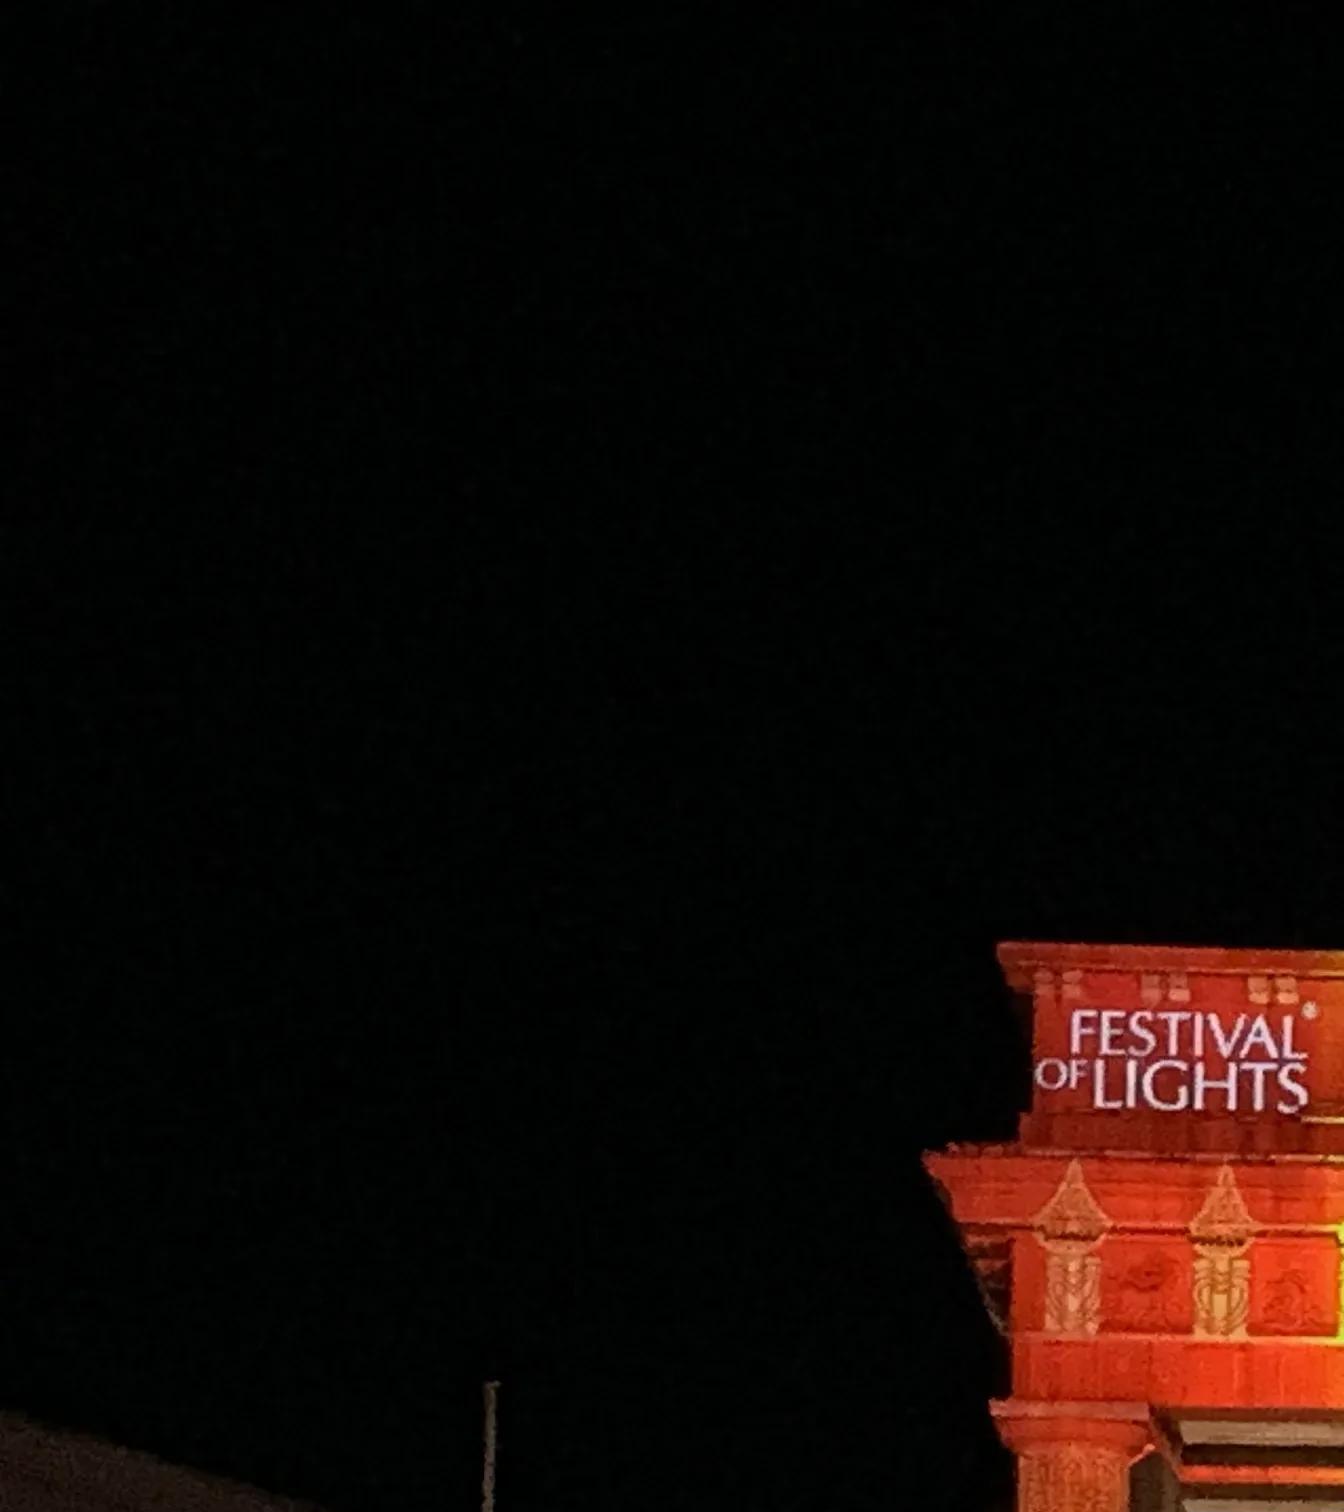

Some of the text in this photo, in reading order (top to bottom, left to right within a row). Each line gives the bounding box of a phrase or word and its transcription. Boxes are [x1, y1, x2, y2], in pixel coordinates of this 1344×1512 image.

[1070, 1008, 1309, 1059] FESTIVAL
[1034, 1058, 1310, 1114] OF LIGHTS
